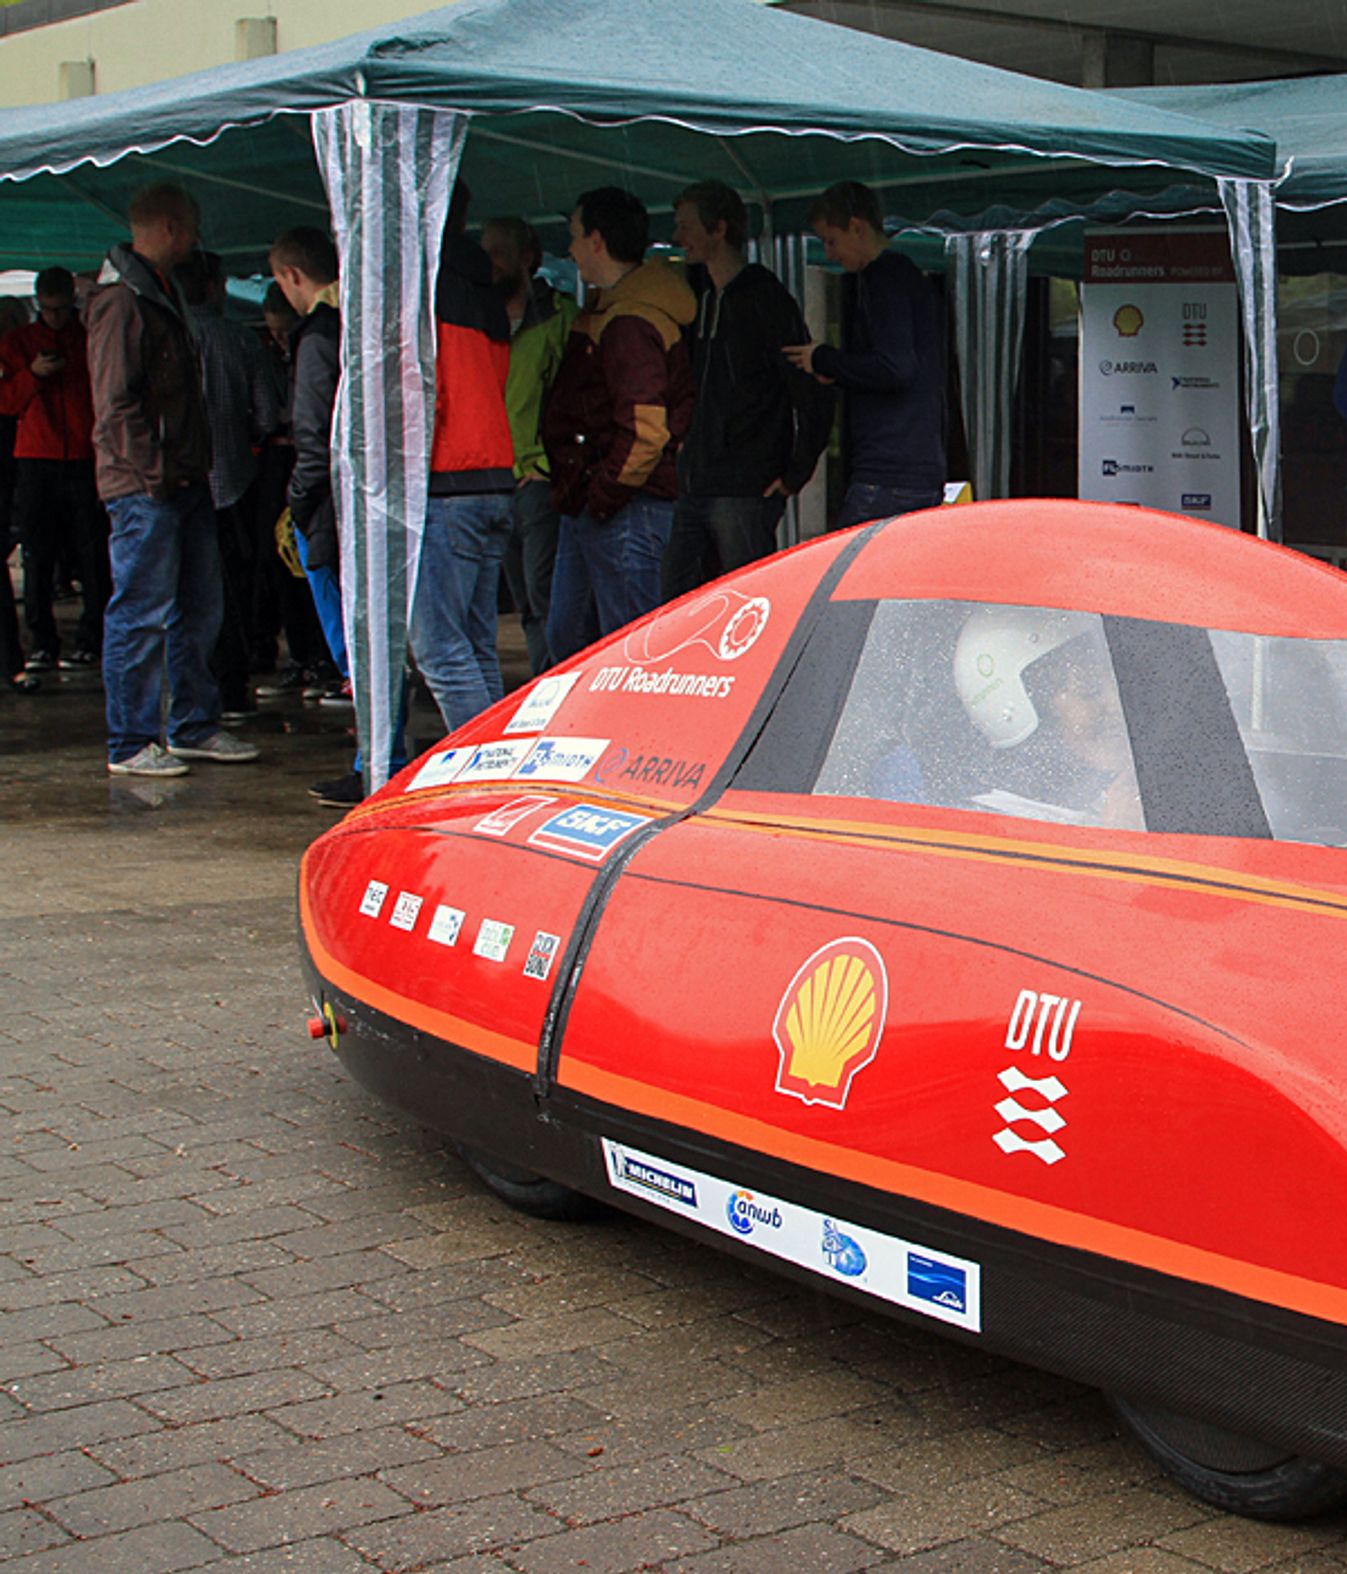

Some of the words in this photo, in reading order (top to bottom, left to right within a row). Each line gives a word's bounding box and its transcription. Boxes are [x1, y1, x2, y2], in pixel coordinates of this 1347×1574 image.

[1091, 249, 1115, 262] DTU
[1091, 264, 1165, 277] Roadrunners
[1183, 302, 1207, 320] DTU
[1113, 361, 1158, 374] ARRIVA
[589, 666, 625, 693] DTU
[622, 667, 736, 698] Roadrunners
[623, 754, 706, 791] ARRIVA
[556, 810, 632, 836] SKF
[1004, 989, 1082, 1062] DTU
[628, 1163, 694, 1198] MICHELIN
[736, 1200, 783, 1230] anwb
